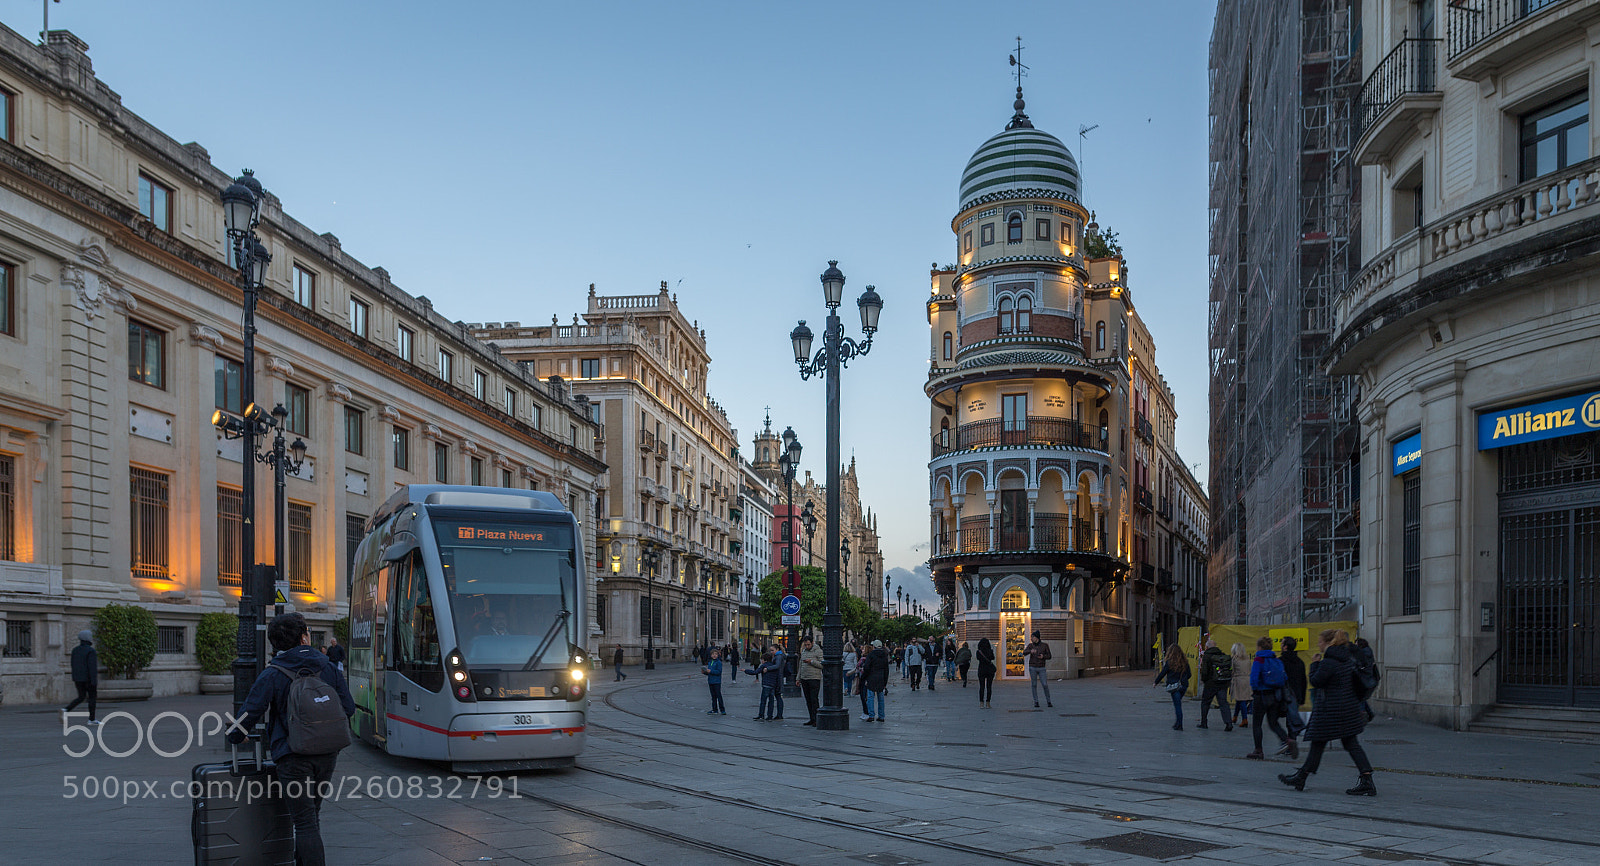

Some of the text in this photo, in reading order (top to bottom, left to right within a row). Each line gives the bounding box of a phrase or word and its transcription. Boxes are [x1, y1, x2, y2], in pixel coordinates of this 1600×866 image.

[1492, 408, 1576, 440] Allianz
[459, 528, 544, 541] T1 Plaza Nueva
[513, 715, 532, 725] 303
